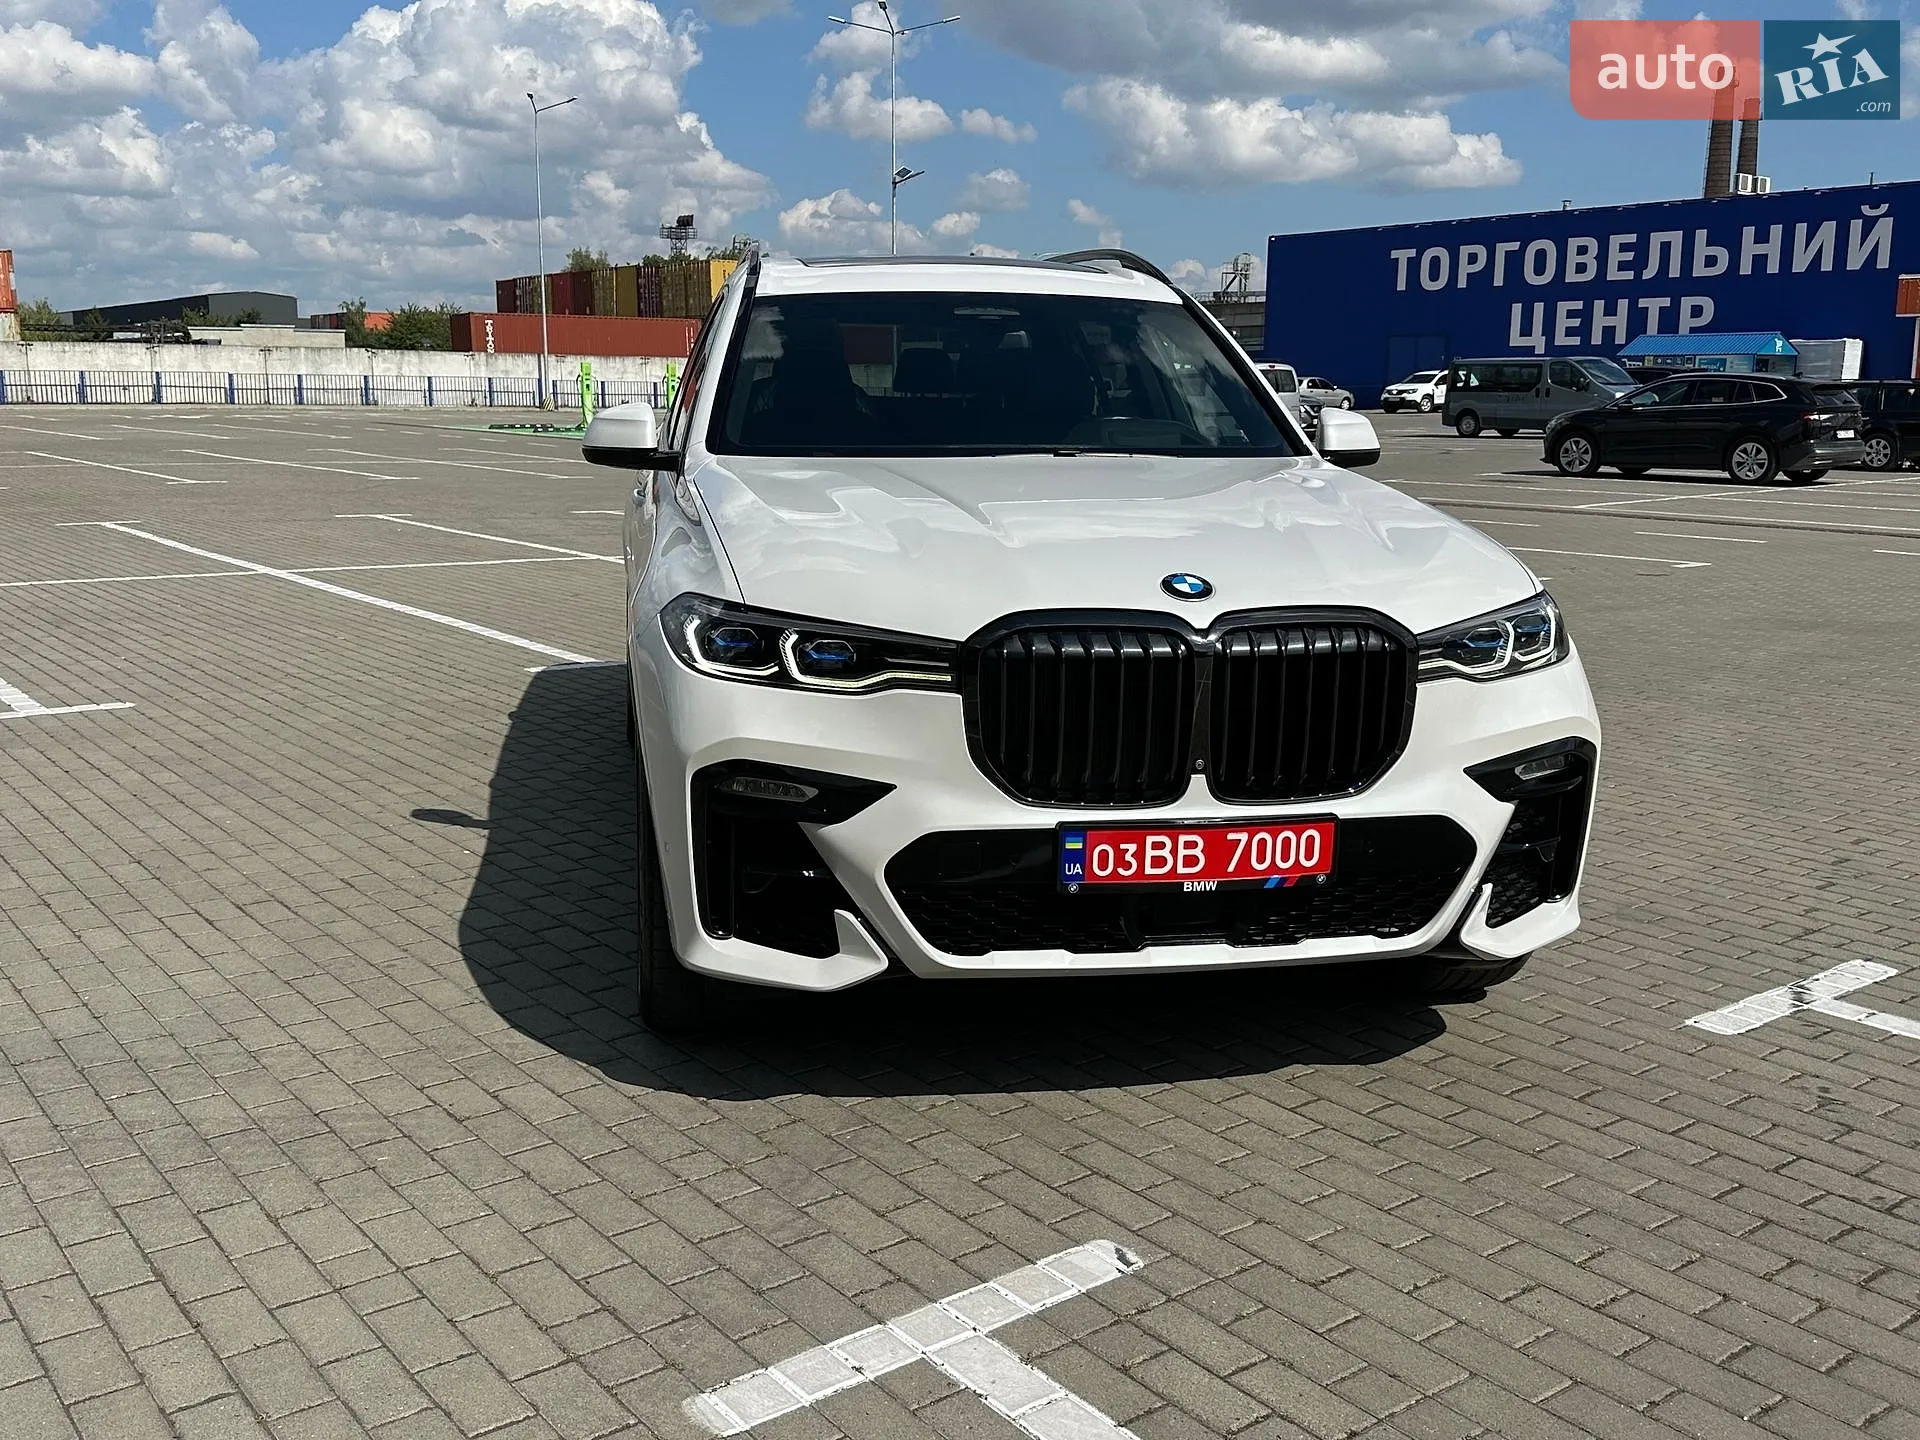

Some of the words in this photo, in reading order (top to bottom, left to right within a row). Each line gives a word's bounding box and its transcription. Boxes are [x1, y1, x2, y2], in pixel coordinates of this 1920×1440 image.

[1390, 203, 1895, 292] ТОРГОВЕЛЬНИЙ
[1508, 296, 1715, 355] ЦЕНТР
[1065, 863, 1083, 876] UA
[1226, 828, 1321, 873] 7000
[1183, 880, 1218, 893] BMW
